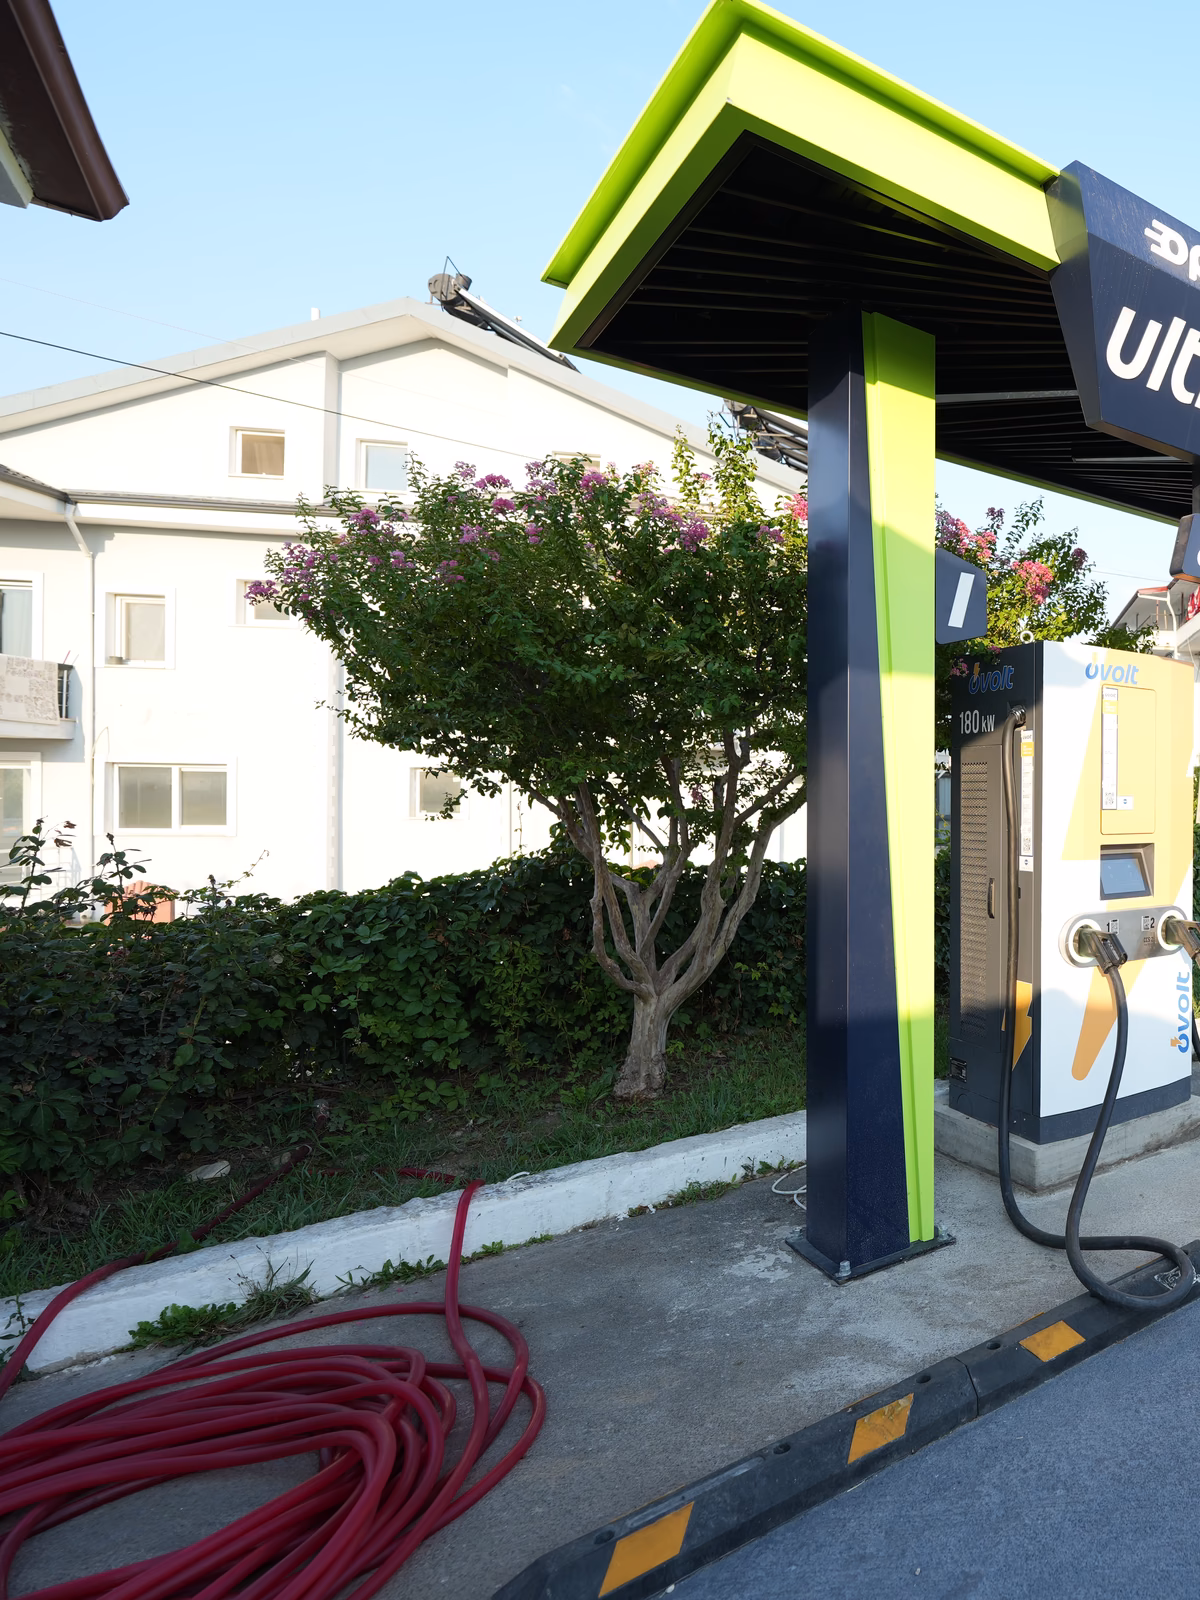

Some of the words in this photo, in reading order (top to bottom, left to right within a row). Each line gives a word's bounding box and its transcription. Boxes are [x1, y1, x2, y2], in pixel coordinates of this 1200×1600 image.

[959, 709, 980, 734] 180
[981, 714, 995, 732] kW
[1150, 917, 1155, 929] 2
